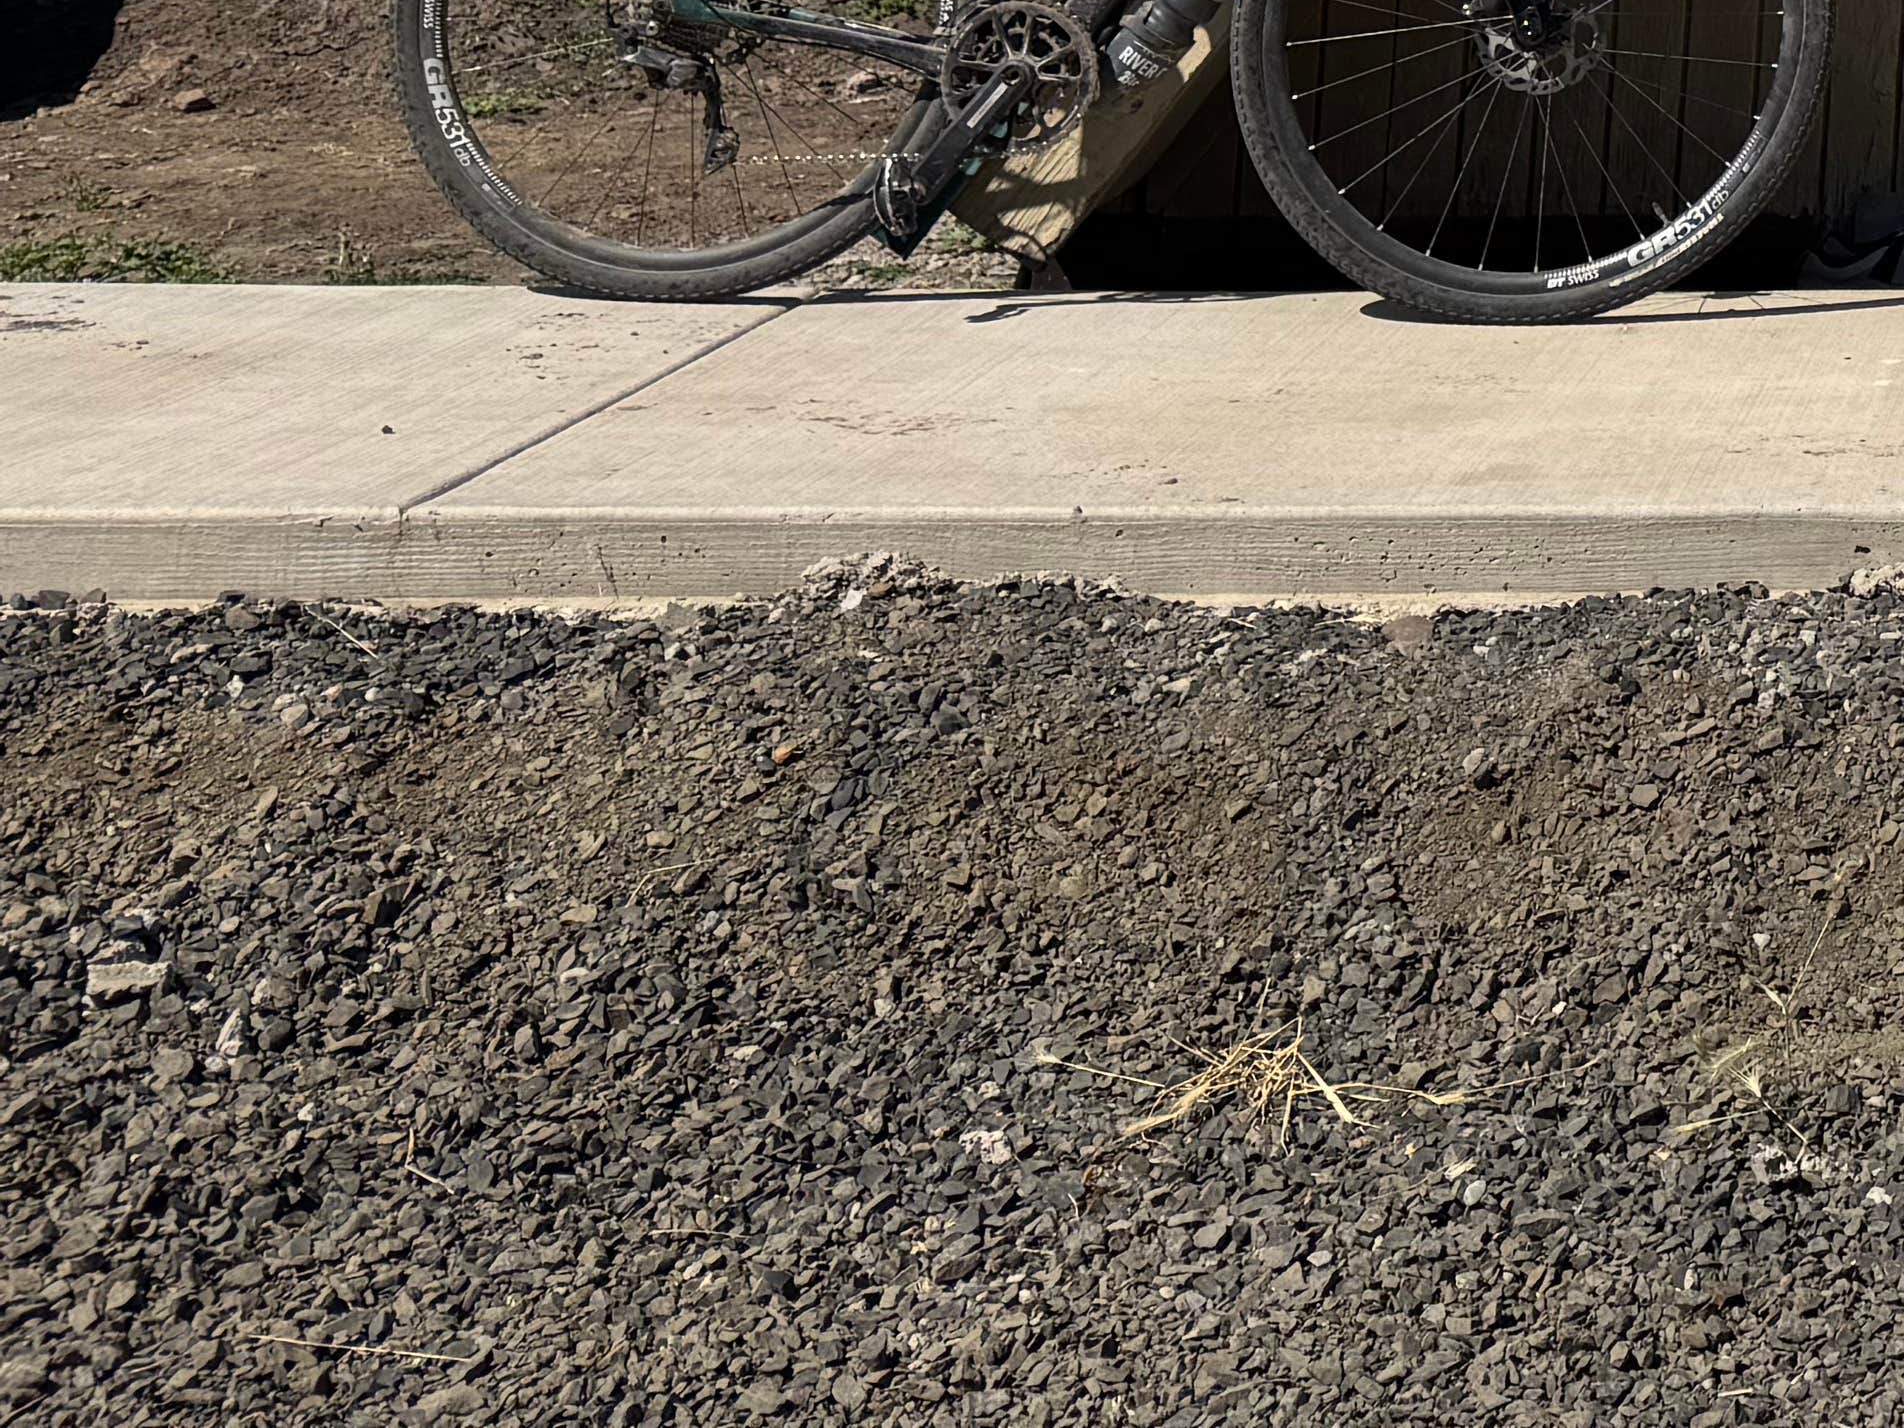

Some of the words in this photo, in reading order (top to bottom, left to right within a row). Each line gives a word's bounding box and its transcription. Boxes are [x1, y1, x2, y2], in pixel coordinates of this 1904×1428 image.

[1118, 46, 1159, 79] RIVER
[1547, 277, 1566, 289] DT
[1567, 269, 1599, 286] SWISS
